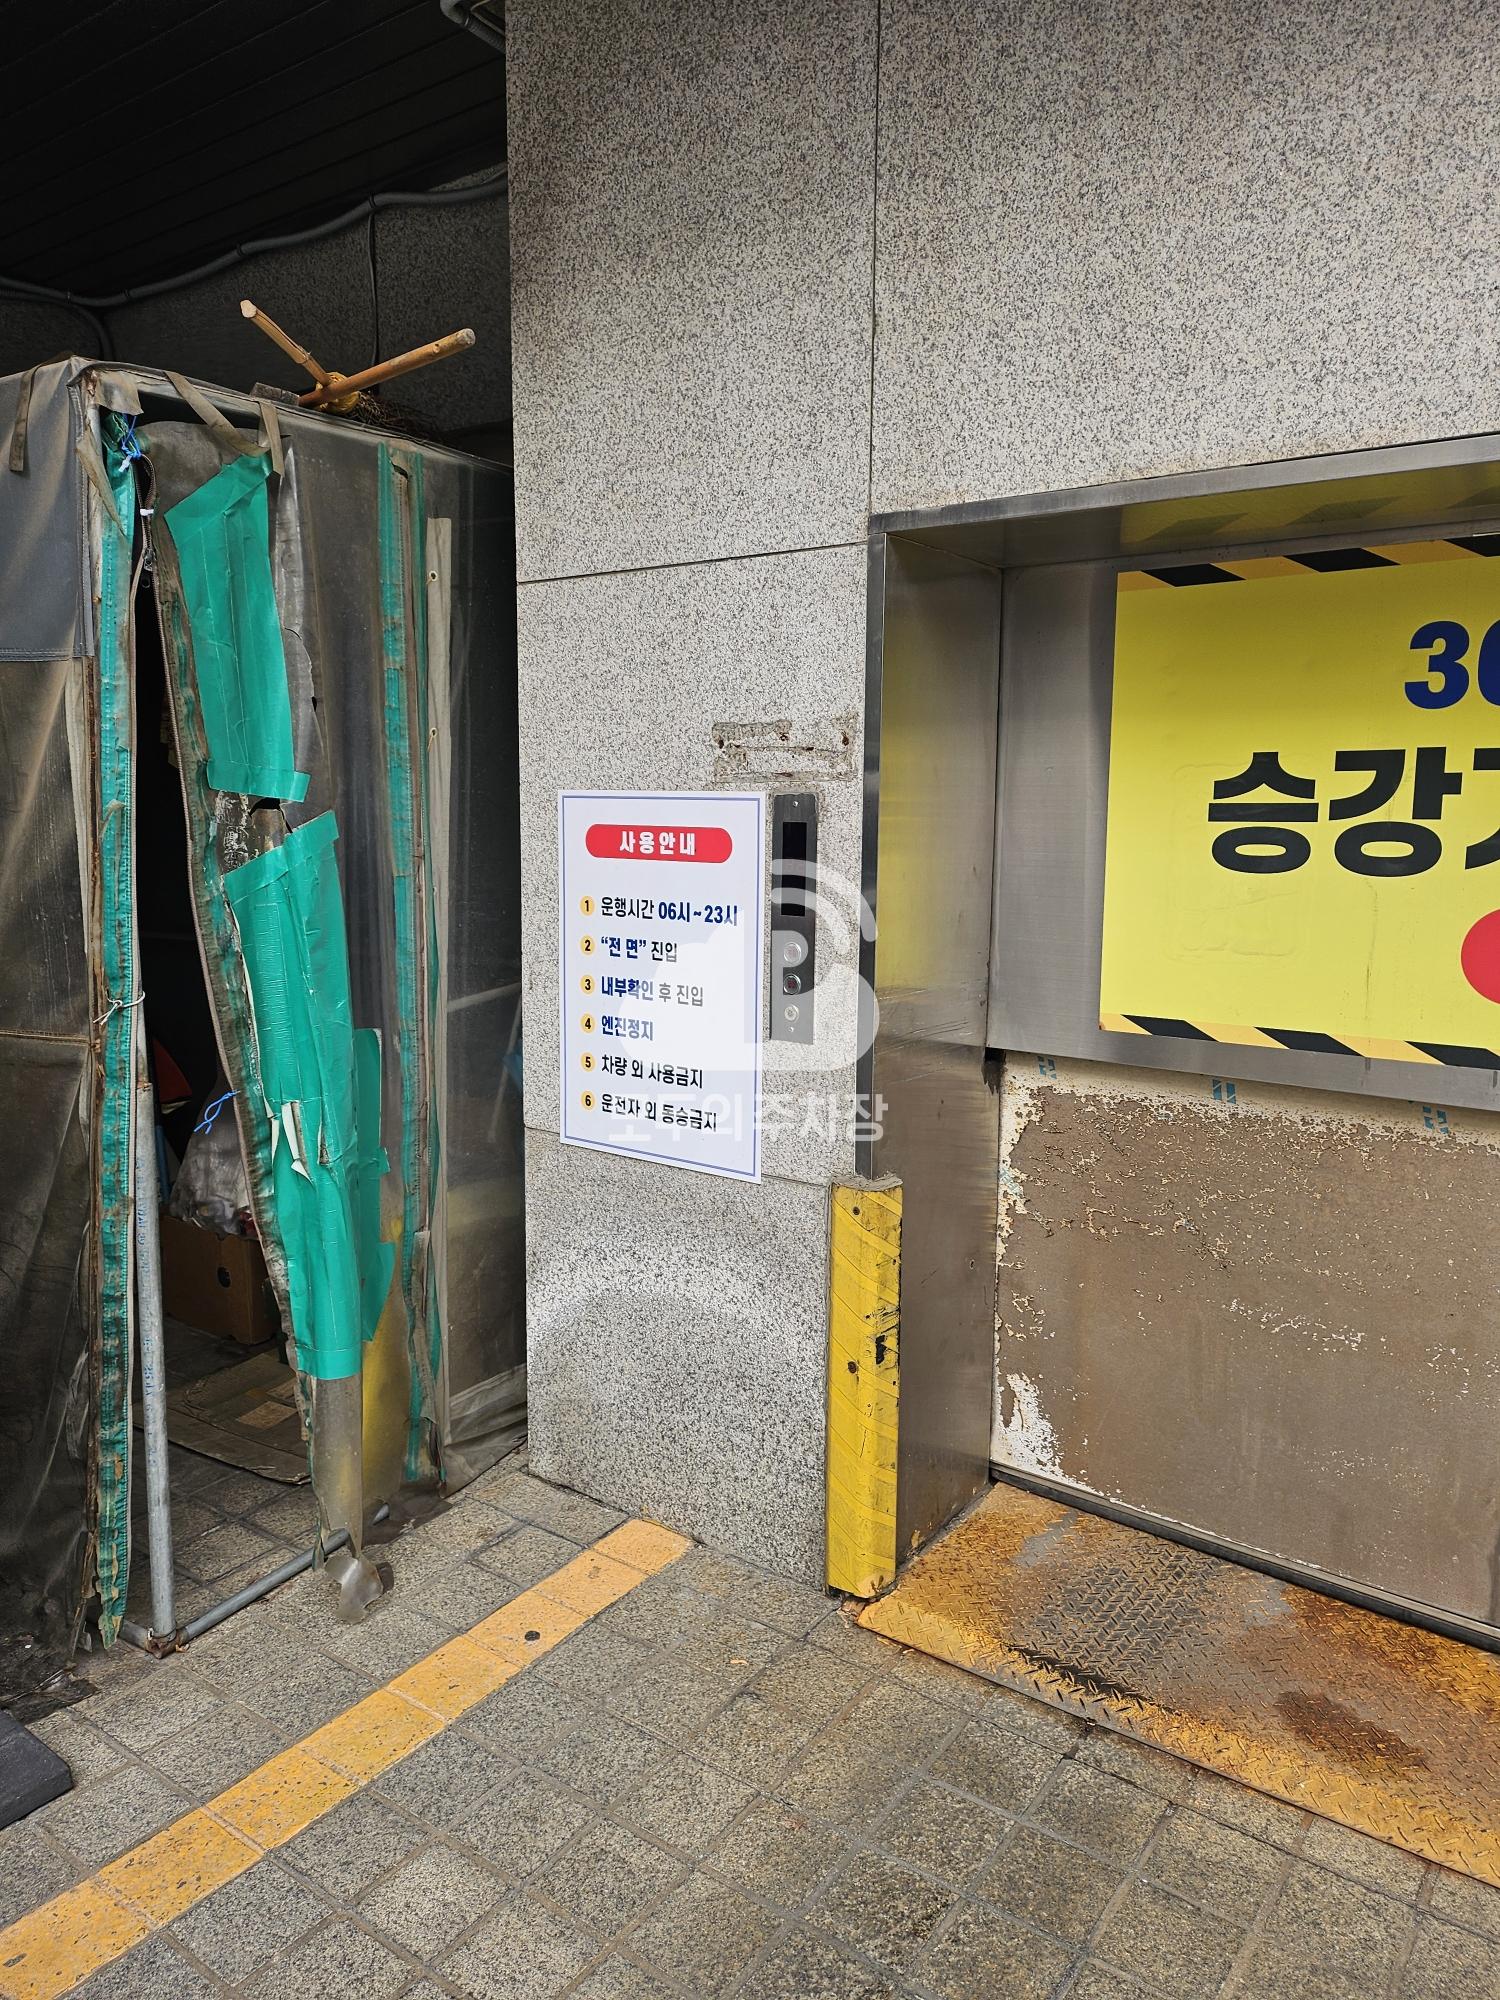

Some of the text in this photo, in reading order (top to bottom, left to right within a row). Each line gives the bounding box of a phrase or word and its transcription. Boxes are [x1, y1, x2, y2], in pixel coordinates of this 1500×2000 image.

[619, 831, 696, 855] 사용안내
[584, 900, 590, 912] 1
[601, 897, 655, 919] 운행시간
[584, 940, 591, 951] 2
[651, 941, 677, 962] 진입
[584, 976, 703, 1007] 3 내부확인 후 진입
[584, 1015, 653, 1041] 4 엔진정지
[585, 1054, 703, 1089] 5 차량 외 사용금지
[585, 1093, 717, 1132] 6 운전자 외 동승금지
